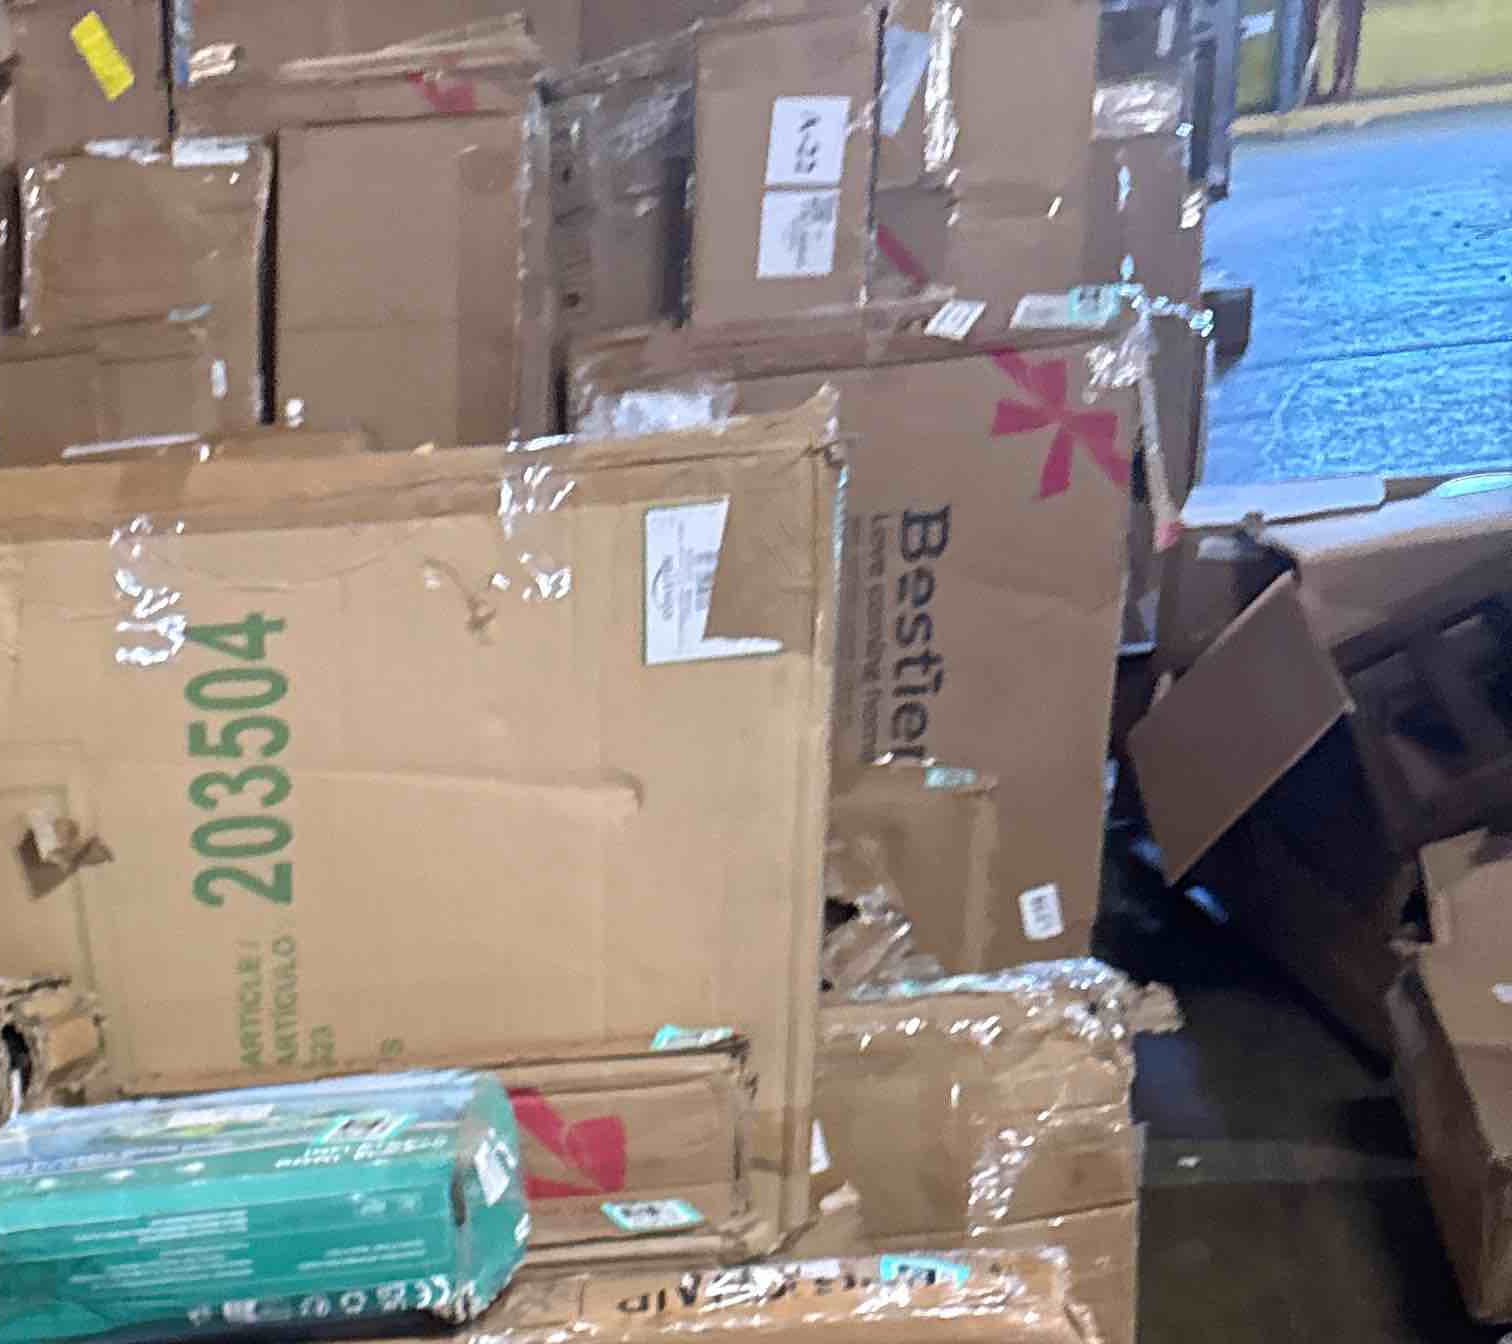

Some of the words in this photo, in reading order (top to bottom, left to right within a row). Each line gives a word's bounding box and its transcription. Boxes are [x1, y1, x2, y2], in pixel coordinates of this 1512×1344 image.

[892, 505, 950, 757] Bestier
[182, 611, 294, 908] 203504
[235, 957, 263, 1067] ARTICLE
